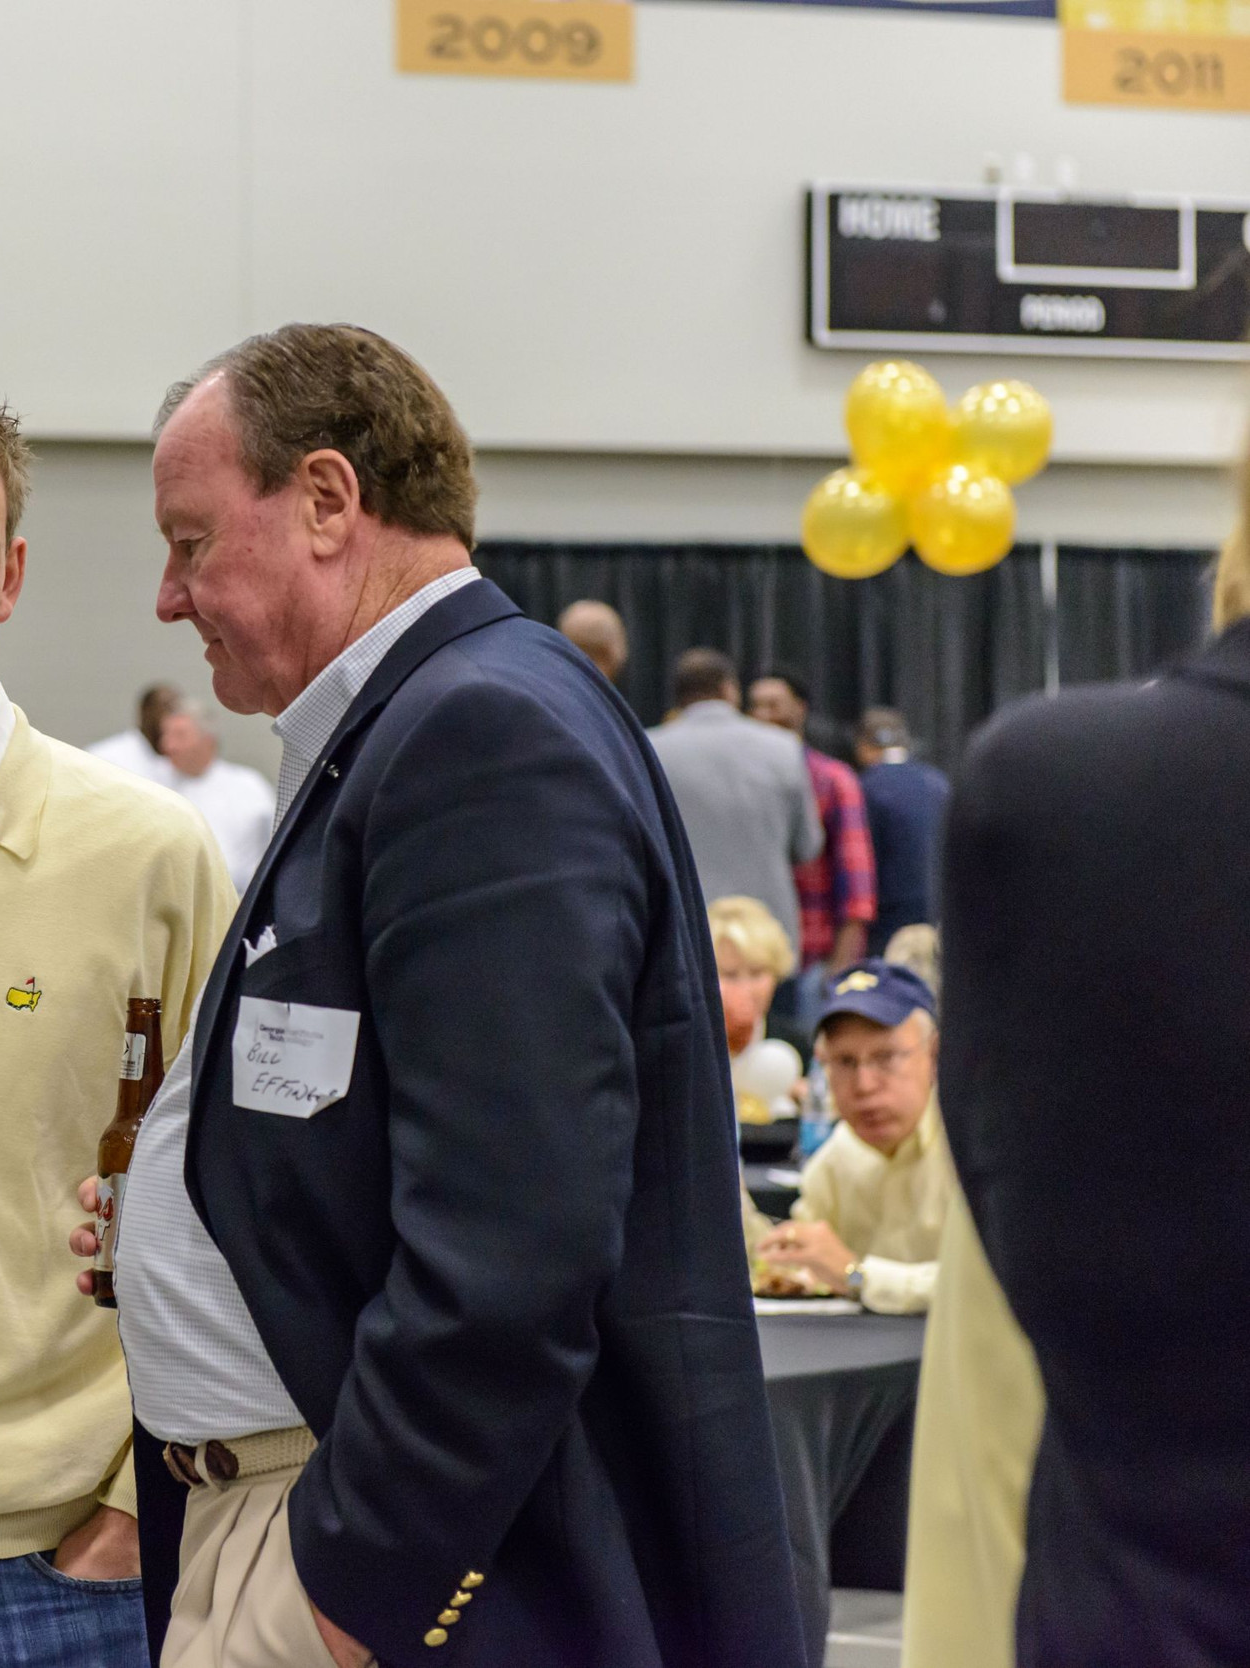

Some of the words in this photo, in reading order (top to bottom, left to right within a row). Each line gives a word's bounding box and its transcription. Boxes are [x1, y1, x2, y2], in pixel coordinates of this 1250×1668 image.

[428, 13, 604, 67] 2009
[1114, 47, 1225, 98] 2011
[838, 197, 941, 241] HOME
[247, 1042, 281, 1065] BILL
